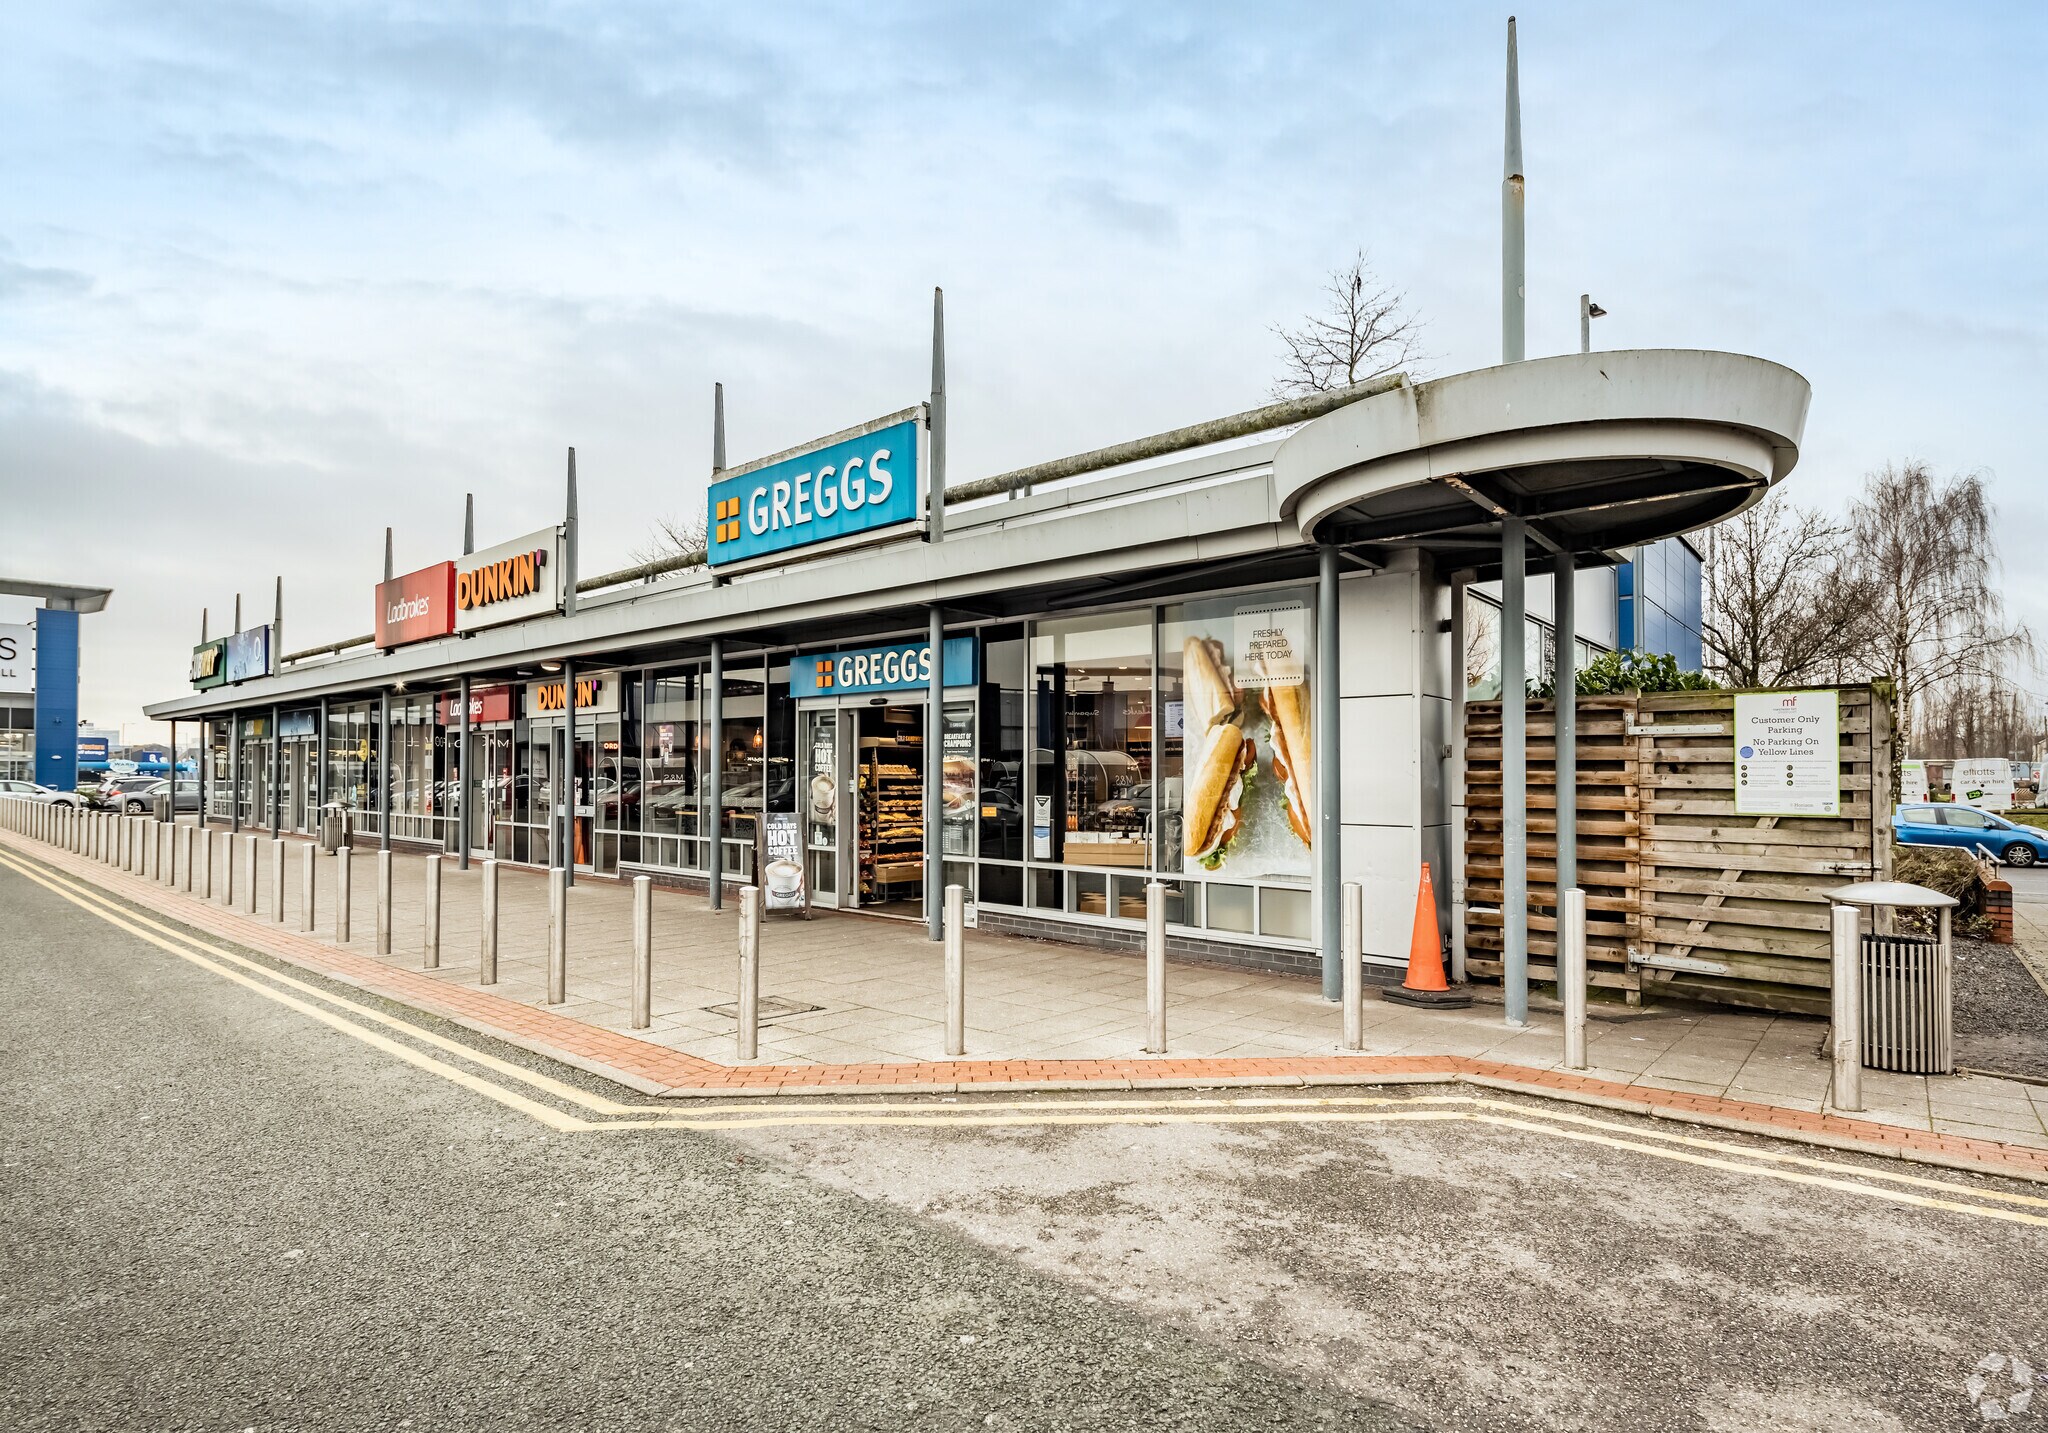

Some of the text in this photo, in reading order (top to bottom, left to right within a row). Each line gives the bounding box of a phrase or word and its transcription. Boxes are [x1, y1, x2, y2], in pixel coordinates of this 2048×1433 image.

[748, 448, 893, 536] GREGGS
[458, 549, 543, 610] DUNKIN'
[387, 593, 430, 624] Ladbrokes
[1253, 628, 1284, 638] FRESHLY
[1249, 639, 1288, 649] PREPARED
[1244, 650, 1293, 661] HERE TODAY
[838, 648, 931, 688] GREGGS
[537, 679, 597, 710] DUNIN'
[1782, 696, 1797, 707] mf
[1751, 715, 1820, 725] Customer Only
[1767, 726, 1803, 735] Parking
[966, 732, 972, 740] OF
[943, 739, 972, 748] CHAMPIONS
[1752, 737, 1819, 747] No Parking On
[815, 749, 833, 763] HOT
[1758, 748, 1815, 756] Yellow Lines
[1963, 768, 1996, 776] elliotts
[783, 822, 797, 830] DAYS
[767, 830, 797, 847] HOT
[768, 846, 798, 856] COFFEE
